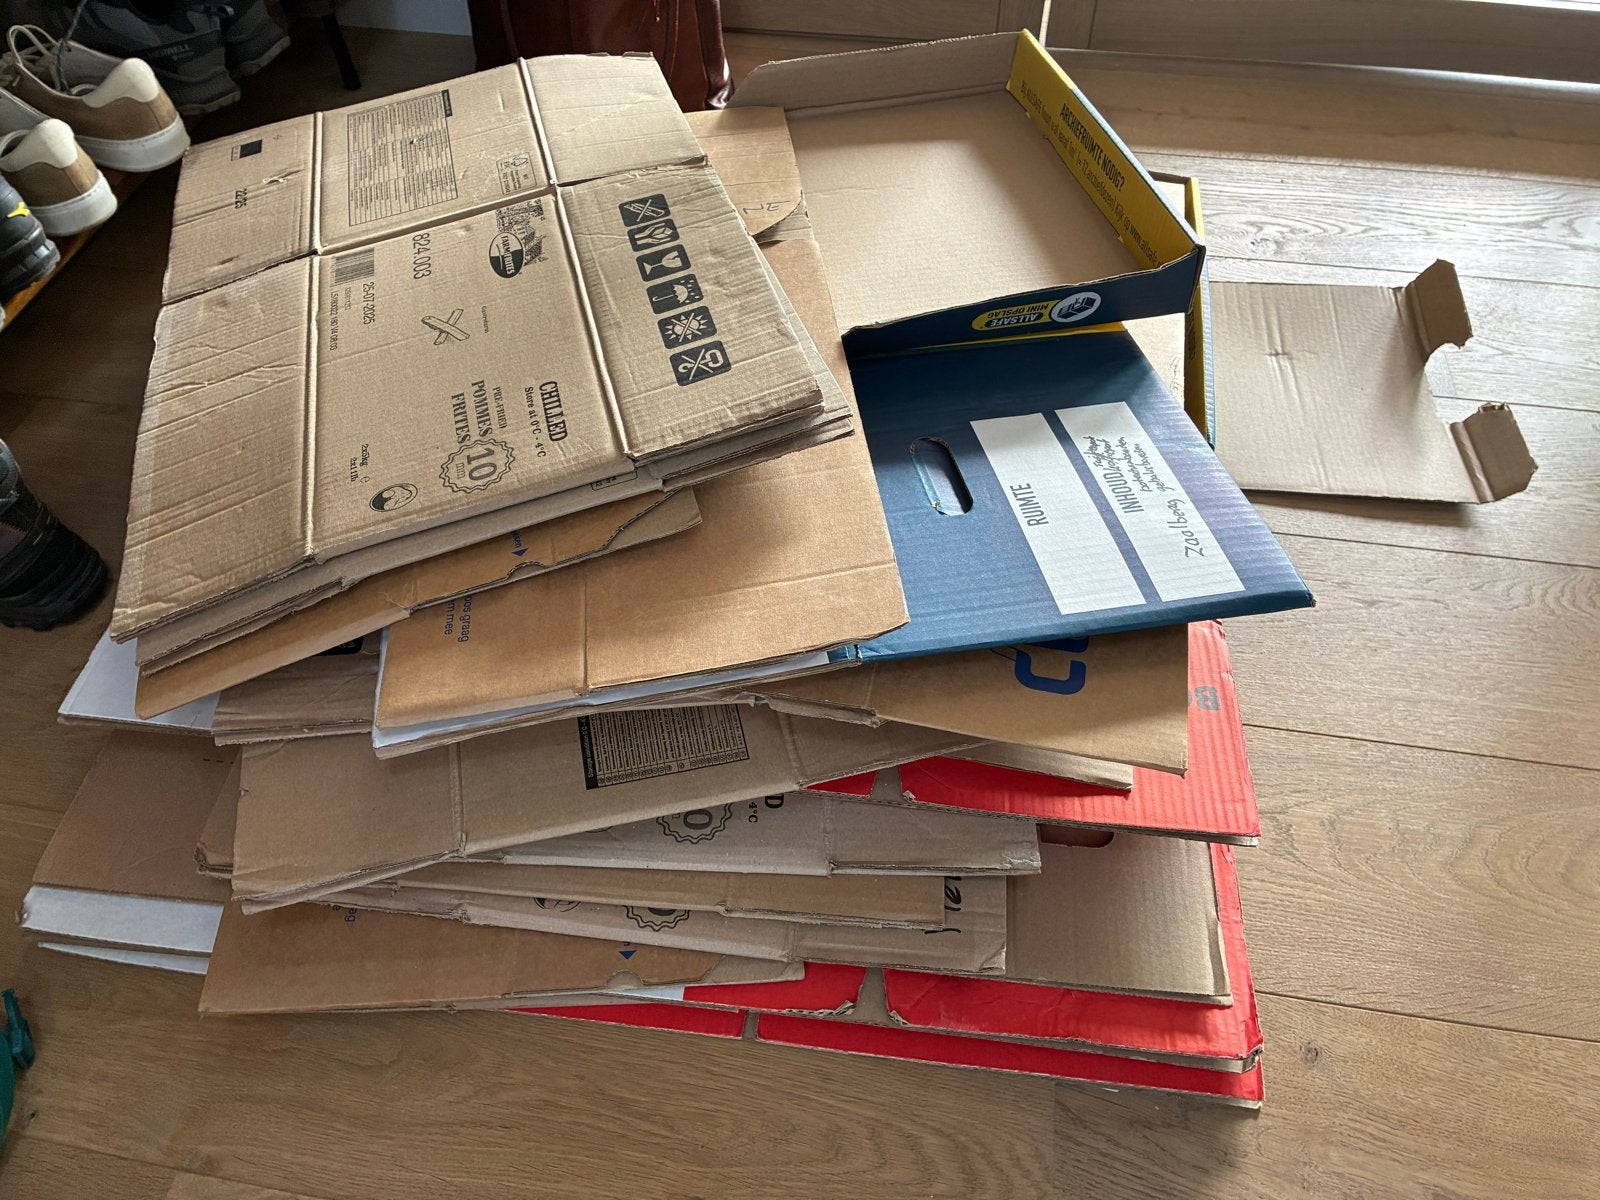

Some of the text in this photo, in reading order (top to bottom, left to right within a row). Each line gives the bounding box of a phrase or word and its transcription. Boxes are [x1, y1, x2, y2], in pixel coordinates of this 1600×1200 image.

[1060, 103, 1125, 192] ARCHIEFRUIMTE NODIG?
[412, 232, 432, 280] 824.003
[362, 281, 376, 325] 25-07-2025
[987, 303, 1049, 319] MINI OPSLAG
[990, 313, 1039, 327] ALLSAFE
[471, 380, 493, 437] POMMES
[493, 386, 508, 429] PRE-FRIED
[524, 386, 535, 408] Store
[528, 409, 537, 419] at
[539, 381, 568, 442] CHILLED
[451, 392, 471, 444] FRITES
[466, 447, 497, 481] 10
[535, 442, 547, 458] 4°C
[1010, 482, 1049, 527] RUIMTE
[1102, 472, 1144, 514] INHOUD
[444, 614, 455, 636] mee
[457, 614, 471, 643] graag
[748, 801, 759, 824] 4°C
